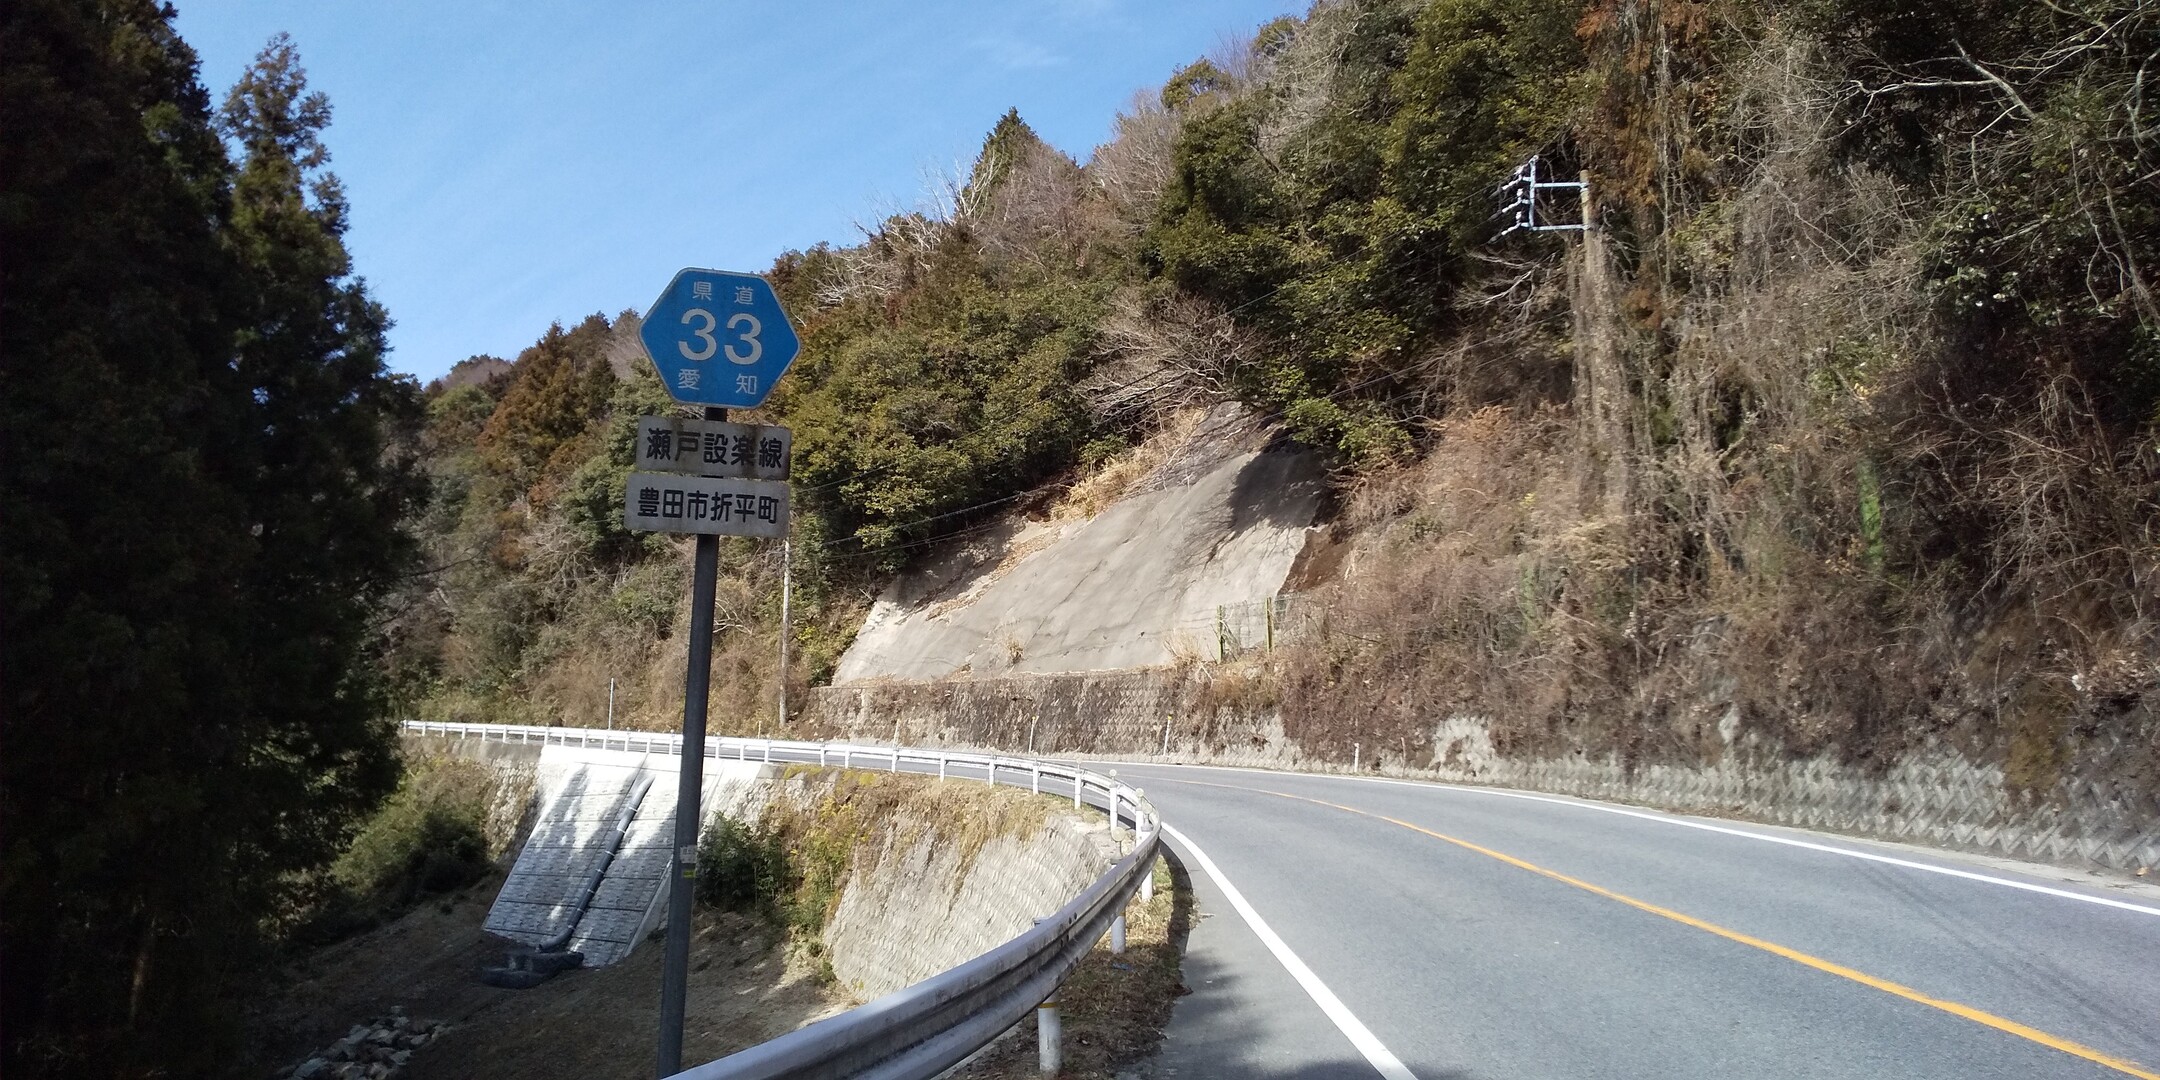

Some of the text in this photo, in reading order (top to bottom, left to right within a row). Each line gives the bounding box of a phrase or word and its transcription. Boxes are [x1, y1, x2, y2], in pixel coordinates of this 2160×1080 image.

[692, 281, 754, 306] 県道
[678, 308, 763, 365] 33
[677, 368, 758, 395] 愛知
[646, 427, 783, 469] 瀬戸設楽線
[637, 487, 779, 524] 豊田市折平町
